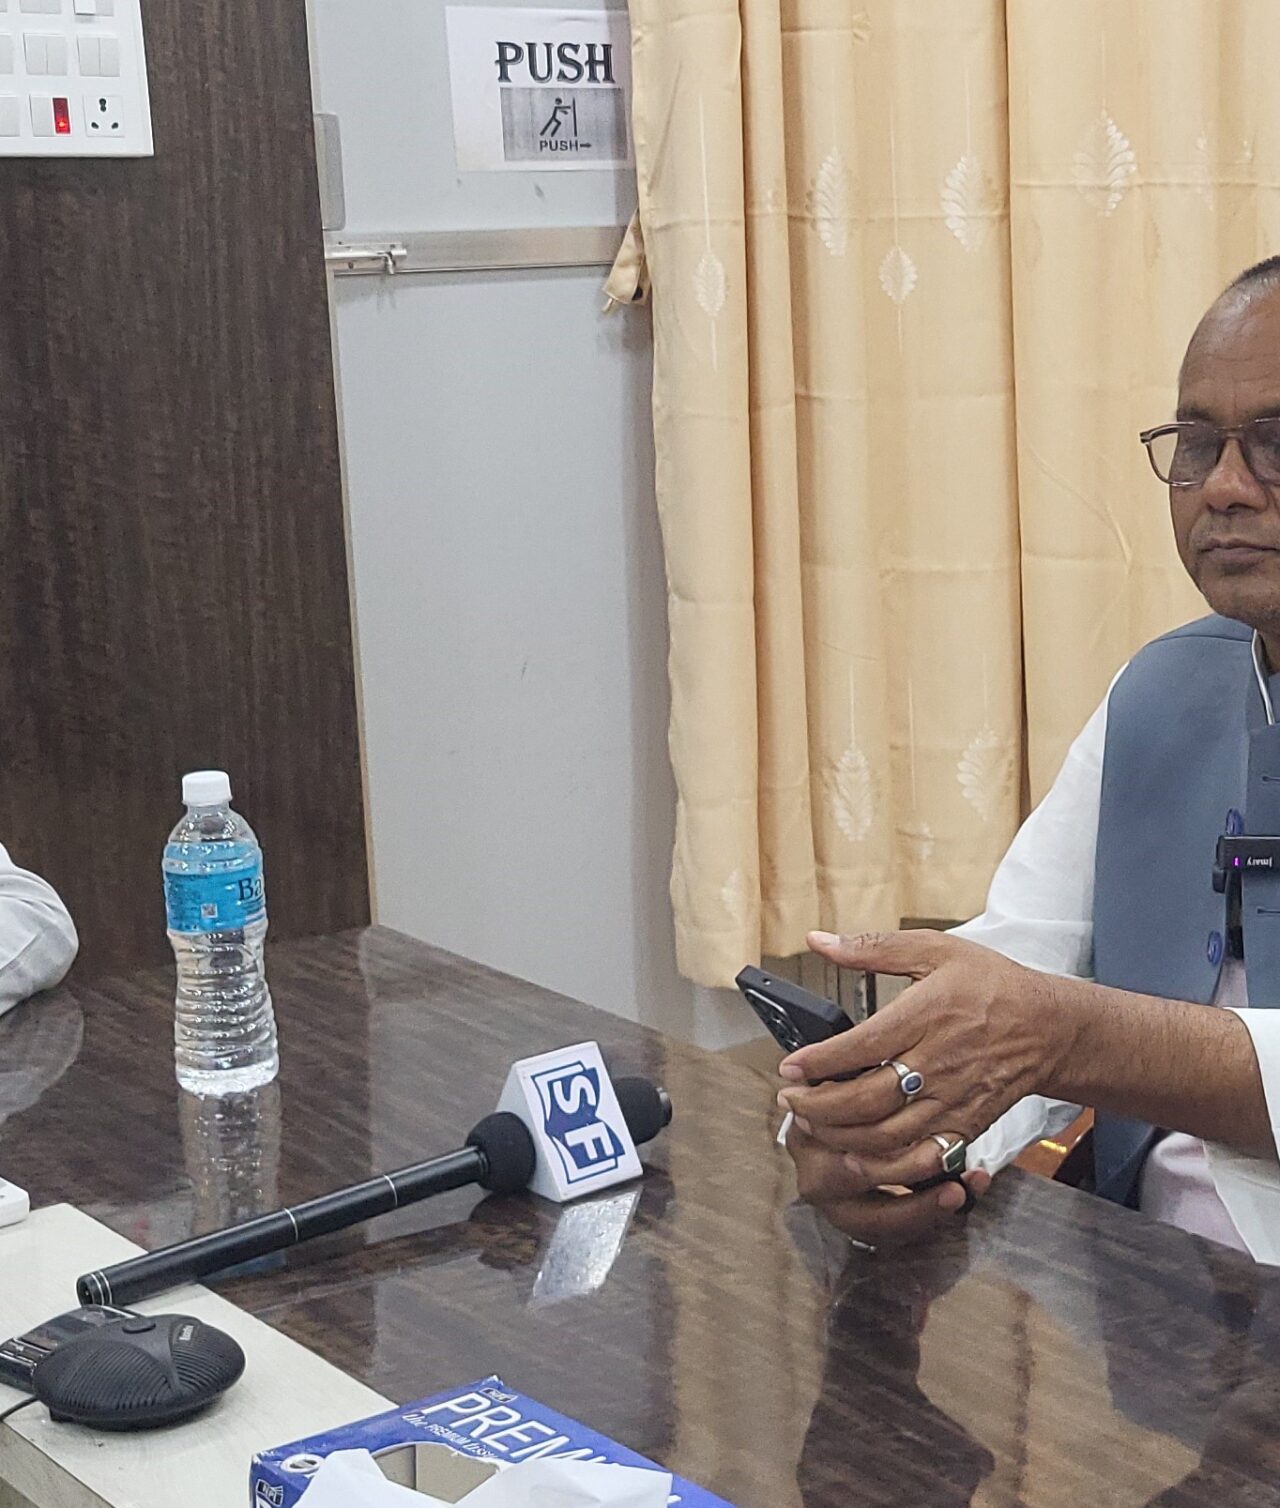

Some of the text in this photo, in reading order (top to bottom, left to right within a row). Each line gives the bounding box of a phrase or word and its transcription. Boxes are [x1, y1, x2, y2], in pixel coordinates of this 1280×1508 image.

[495, 41, 616, 84] PUSH
[540, 139, 579, 152] PUSH
[238, 878, 262, 901] Ba
[552, 1074, 615, 1161] SF
[420, 1392, 607, 1464] PREM
